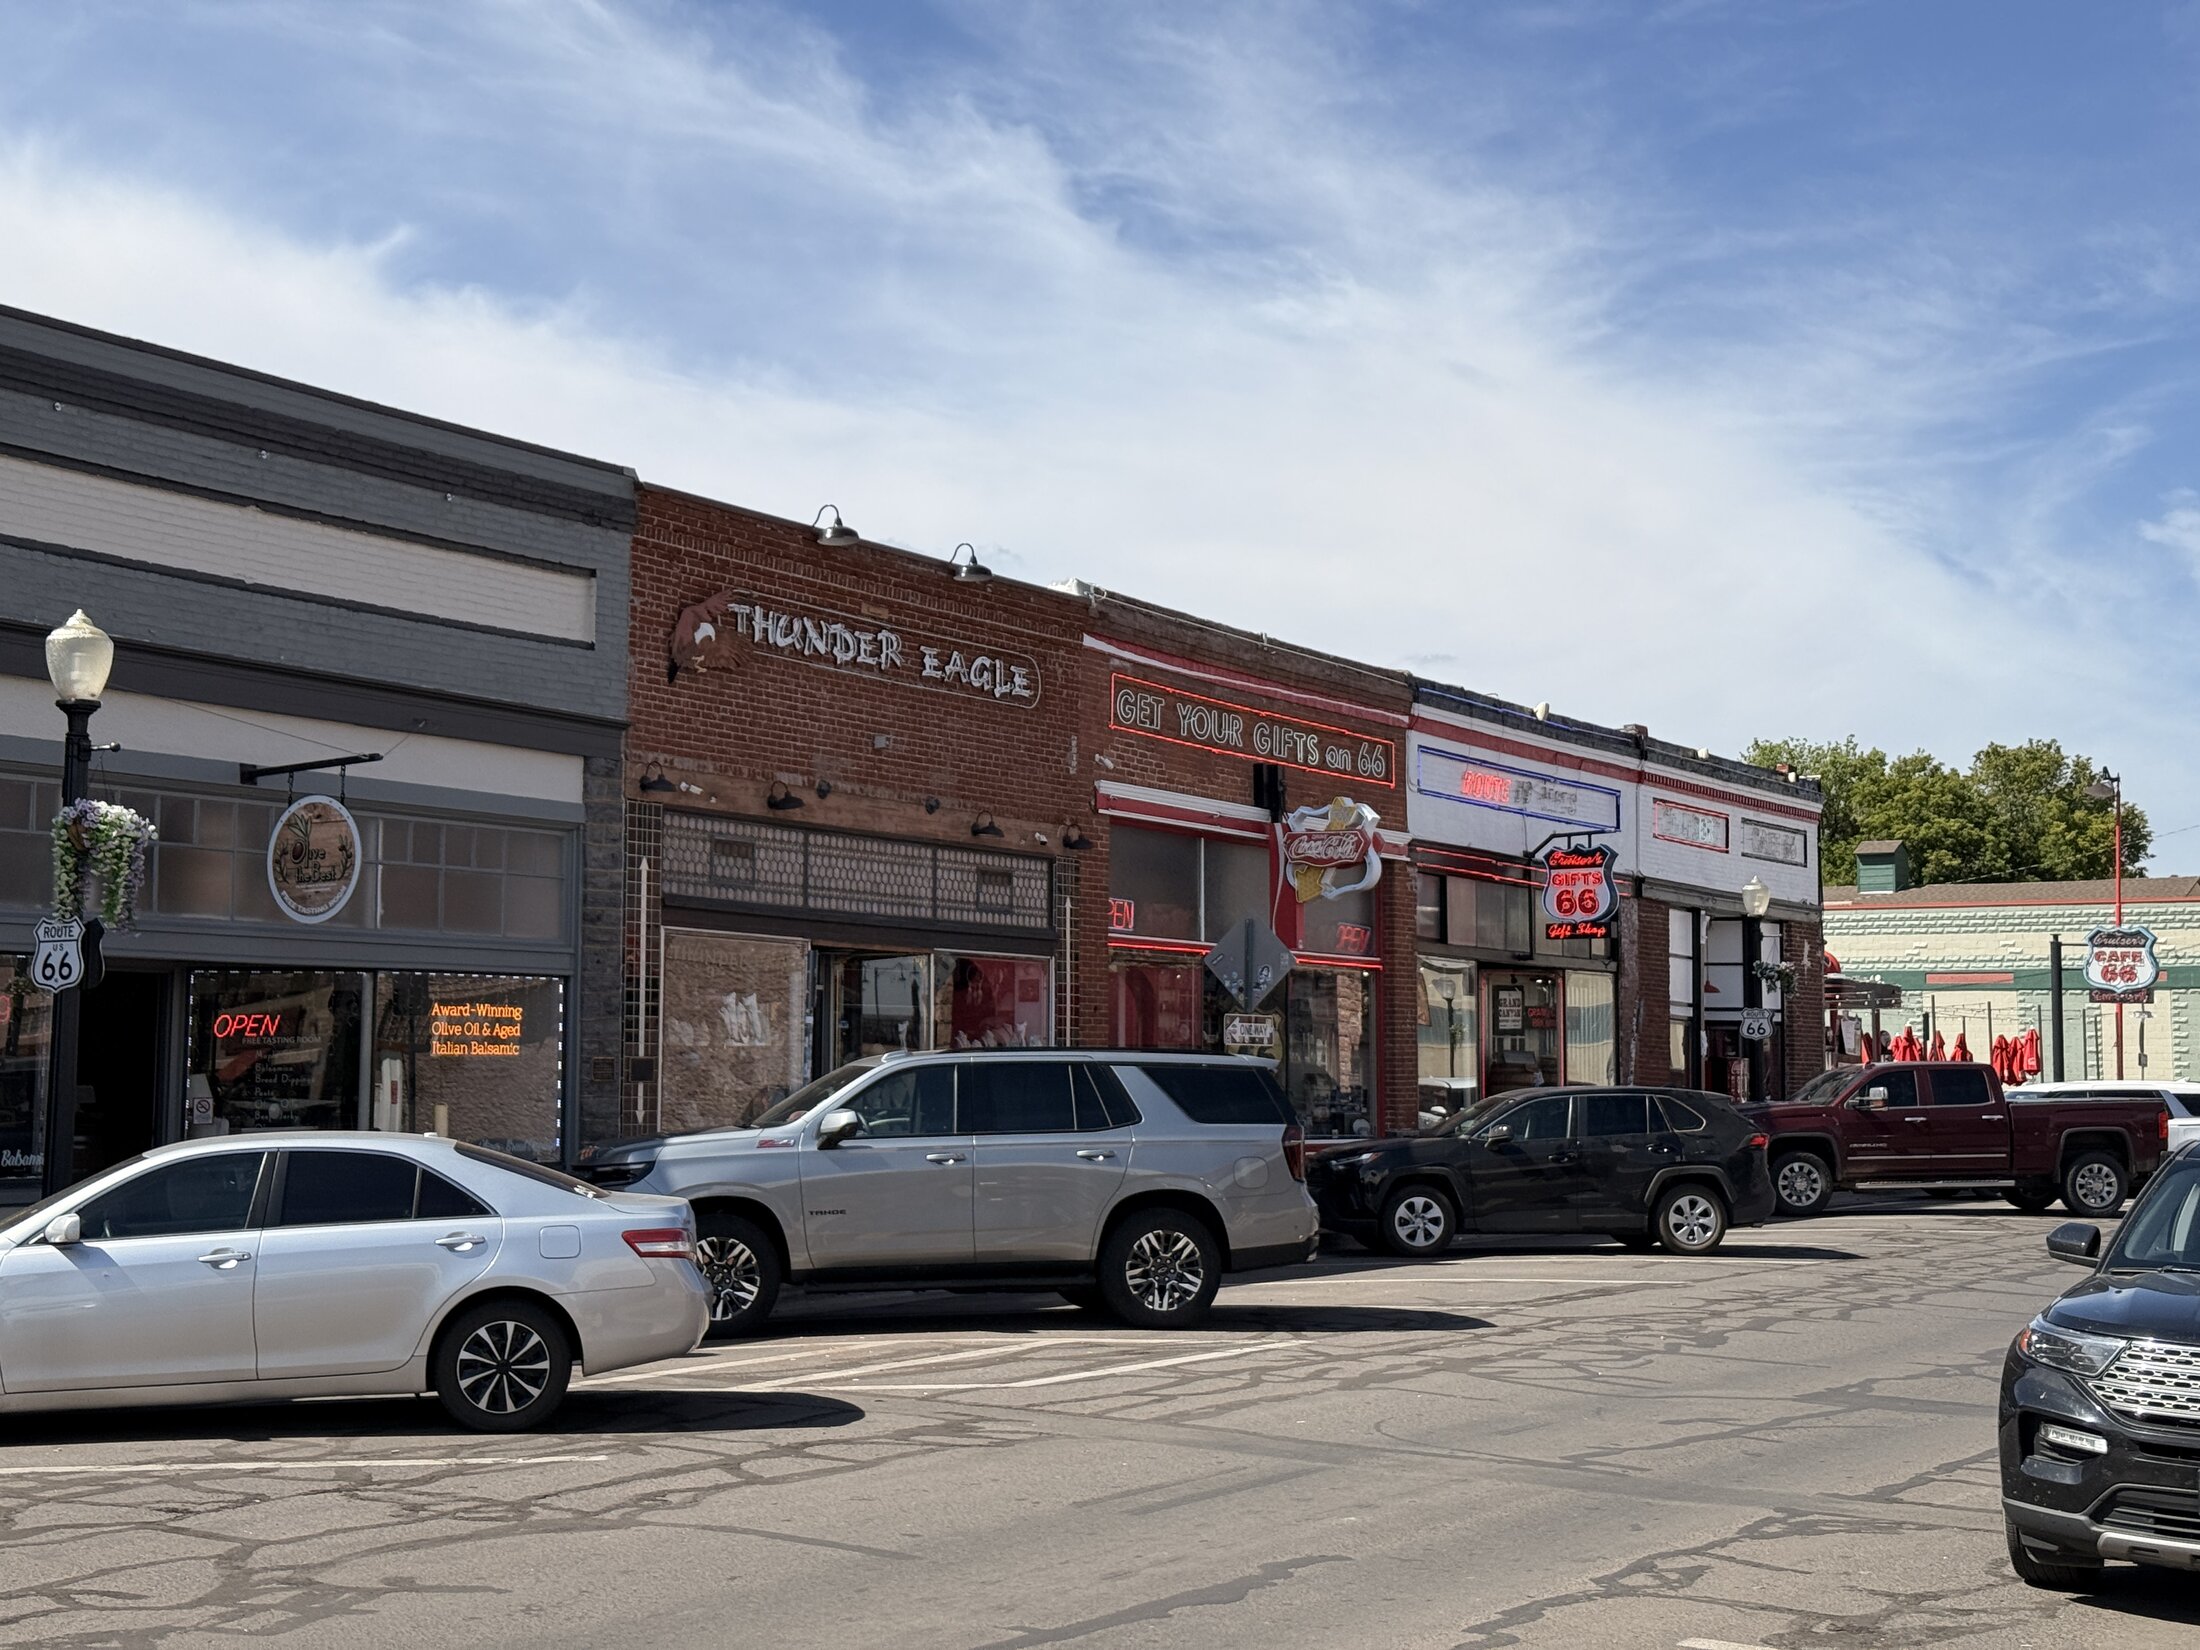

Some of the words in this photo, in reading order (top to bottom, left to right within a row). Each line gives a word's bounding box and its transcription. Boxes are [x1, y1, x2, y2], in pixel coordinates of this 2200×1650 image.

[728, 602, 904, 669] THUNDER
[919, 645, 1034, 699] EAGLE
[1116, 689, 1165, 729] GET
[1176, 702, 1243, 747] YOUR
[1253, 722, 1319, 766] GIFTS
[1325, 745, 1351, 771] on
[1357, 742, 1386, 778] 66
[1461, 770, 1512, 804] ROUTE
[1552, 871, 1604, 887] GIFTS
[1556, 888, 1599, 917] 66
[1106, 899, 1135, 928] PEN
[43, 925, 75, 939] ROUTE
[1576, 923, 1606, 937] Shop
[2094, 950, 2144, 963] CAFE
[42, 951, 73, 981] 66
[2100, 963, 2138, 982] 66
[431, 1002, 523, 1020] Award-Winning
[213, 1014, 281, 1038] OPEN
[431, 1021, 462, 1036] Olive
[464, 1021, 480, 1036] Oil
[482, 1022, 491, 1036] &
[492, 1022, 521, 1039] Aged
[1240, 1024, 1253, 1036] ONE
[1254, 1024, 1267, 1037] WAY
[1746, 1022, 1766, 1035] 66
[262, 1037, 295, 1045] TASTING
[431, 1041, 469, 1056] Italian
[470, 1041, 520, 1056] Balsamic
